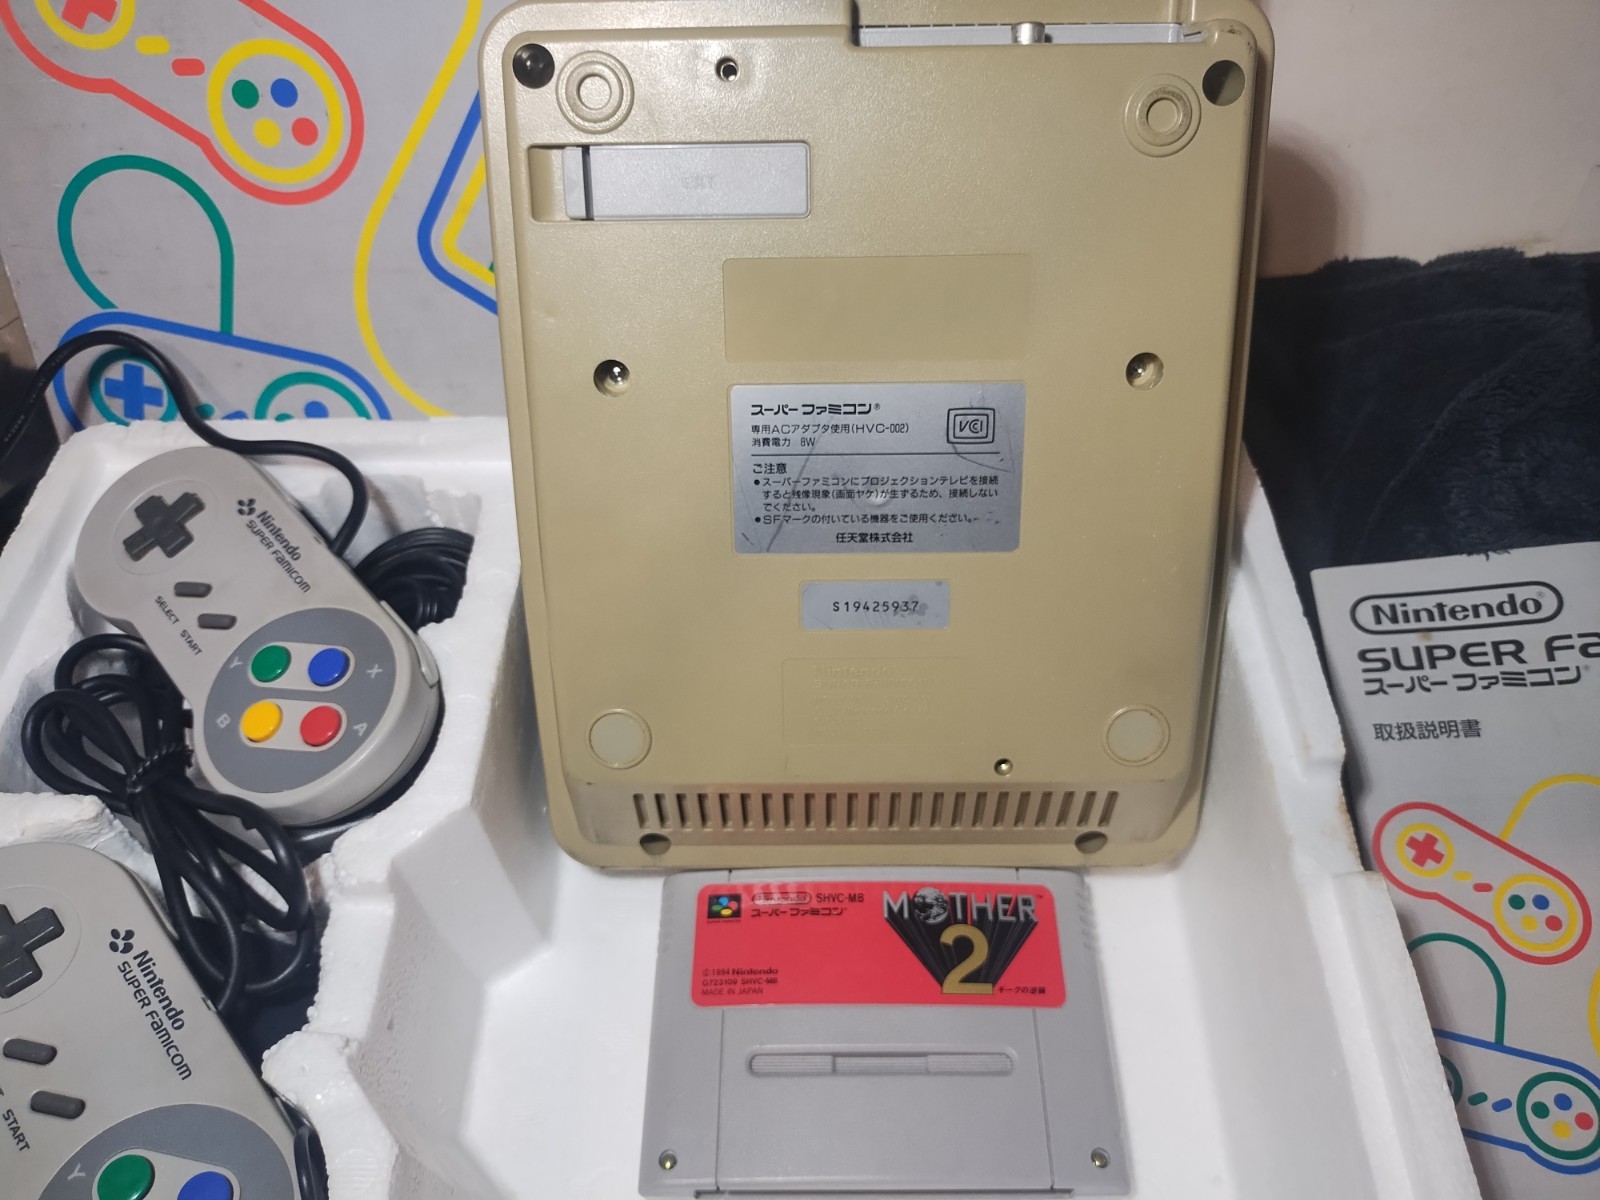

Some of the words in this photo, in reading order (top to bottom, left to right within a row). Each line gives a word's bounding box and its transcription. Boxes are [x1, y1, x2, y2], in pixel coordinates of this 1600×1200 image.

[751, 404, 798, 416] スーパー
[751, 423, 909, 435] 専用ACアダプタ使用(HVC-002)
[752, 437, 791, 448] 消費電力
[800, 437, 816, 447] 8W
[752, 462, 788, 475] ご注意
[763, 502, 816, 512] でください。
[763, 513, 972, 525] SFマークの付いている機器をご使用ください。
[246, 519, 275, 550] SUPER
[256, 510, 302, 561] Nintendo
[835, 532, 914, 544] 任天堂株式会社
[832, 601, 920, 613] S19425937
[155, 595, 181, 625] SELECT
[180, 629, 203, 656] START
[1357, 638, 1528, 673] SUPER
[229, 656, 243, 670] Y
[366, 663, 384, 679] X
[1363, 674, 1448, 696] スーパー
[216, 713, 231, 728] B
[353, 722, 369, 737] A
[1373, 719, 1482, 741] 取扱説明書
[815, 892, 865, 904] SHVC-MB
[751, 908, 787, 917] スーパー
[939, 923, 994, 995] 2
[732, 967, 779, 975] Nintendo
[117, 960, 151, 1010] SUPER
[132, 950, 185, 1031] Nintendo
[702, 988, 724, 996] MADE
[738, 986, 764, 995] JAPAN
[2, 1108, 31, 1152] START
[67, 1163, 86, 1180] Y
